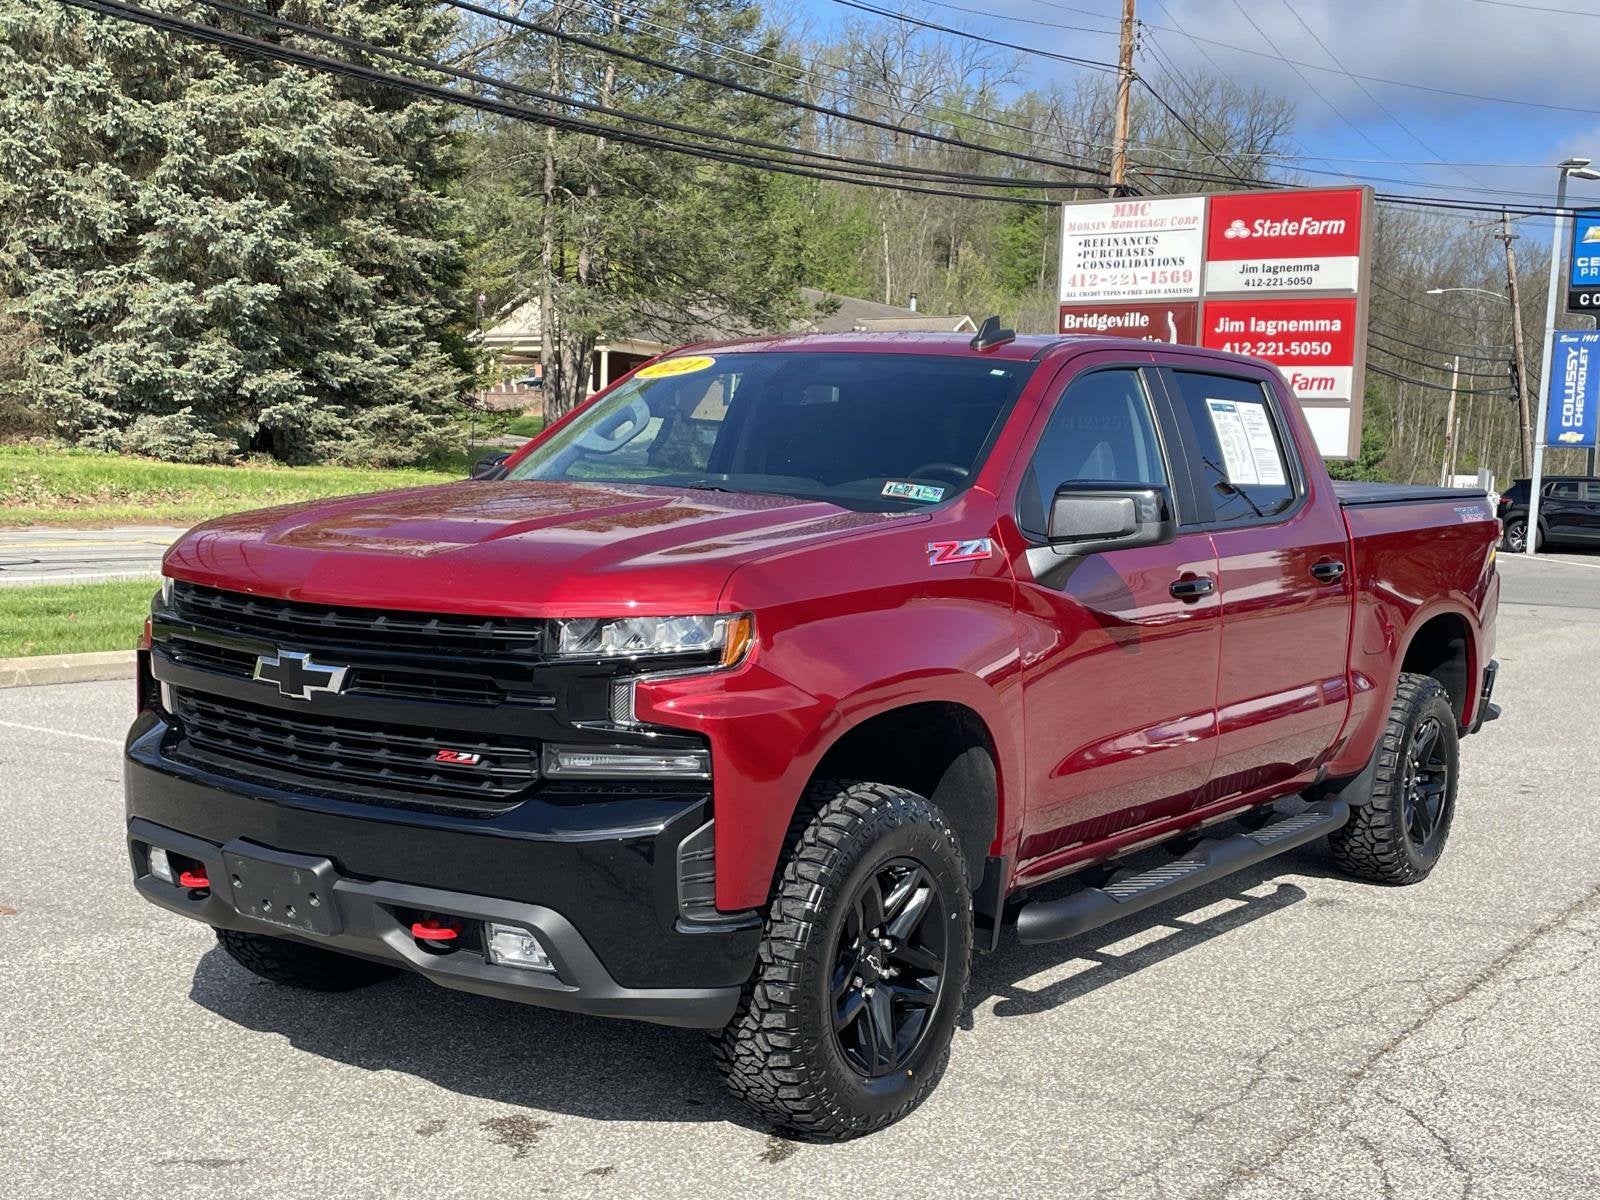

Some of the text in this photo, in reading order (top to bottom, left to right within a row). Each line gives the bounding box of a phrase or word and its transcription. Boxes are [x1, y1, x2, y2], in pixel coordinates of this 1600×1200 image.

[1112, 202, 1152, 218] MMC
[1110, 218, 1167, 231] MORTGAGE
[1083, 235, 1159, 248] REFINANCES
[1083, 247, 1155, 259] PURCHASES
[1082, 256, 1185, 270] CONSOLIDATIONS
[1239, 263, 1320, 275] Jim Iagnemma
[1067, 269, 1193, 287] 412-221-1569
[1244, 276, 1313, 287] 412-221-5050
[1064, 312, 1150, 331] Bridgeville
[1214, 317, 1342, 336] Jim Iagnemma
[1222, 341, 1332, 356] 412-221-5050
[1561, 346, 1579, 428] COLUSSY
[1574, 346, 1589, 428] CHEVROLET
[926, 537, 993, 566] Z71
[434, 750, 481, 765] Z71
